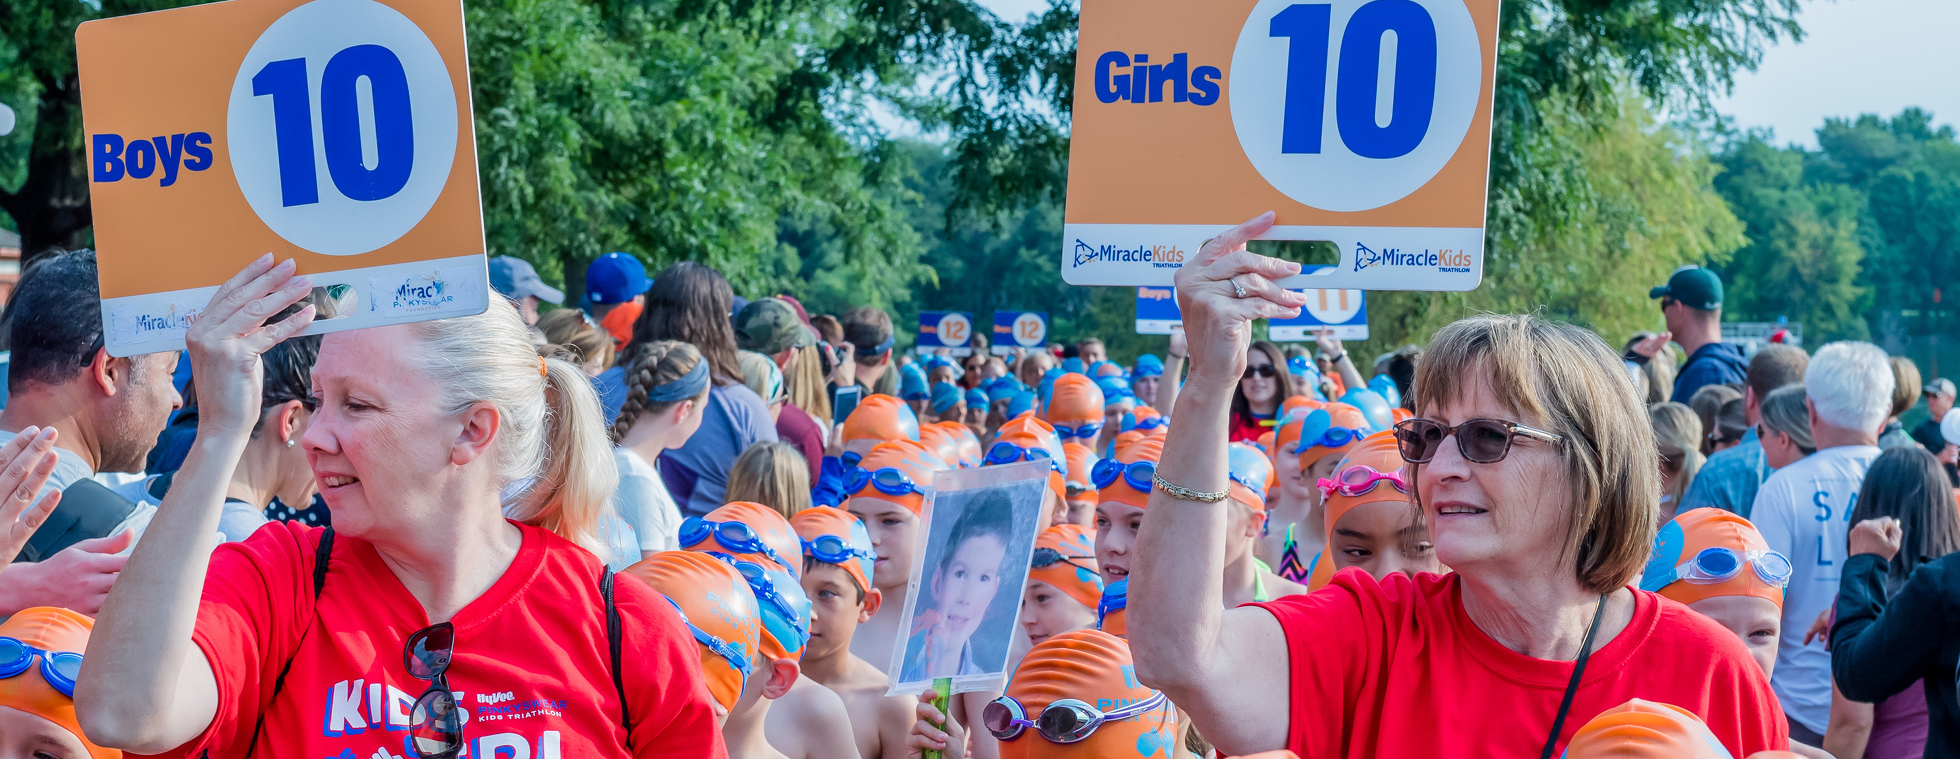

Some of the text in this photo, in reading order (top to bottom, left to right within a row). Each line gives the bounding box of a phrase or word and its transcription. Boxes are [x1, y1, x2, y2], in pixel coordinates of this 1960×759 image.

[1095, 0, 1437, 159] Girls 10
[93, 44, 414, 207] Boys 10
[1100, 244, 1184, 262] MiracleKids
[1382, 248, 1472, 267] MiracleKids
[1138, 287, 1172, 301] Boys
[944, 321, 965, 340] 12
[1020, 321, 1039, 340] 12
[323, 678, 469, 737] KIDS
[478, 699, 567, 714] PINKYSWEAR
[507, 709, 562, 720] TRIATHLON
